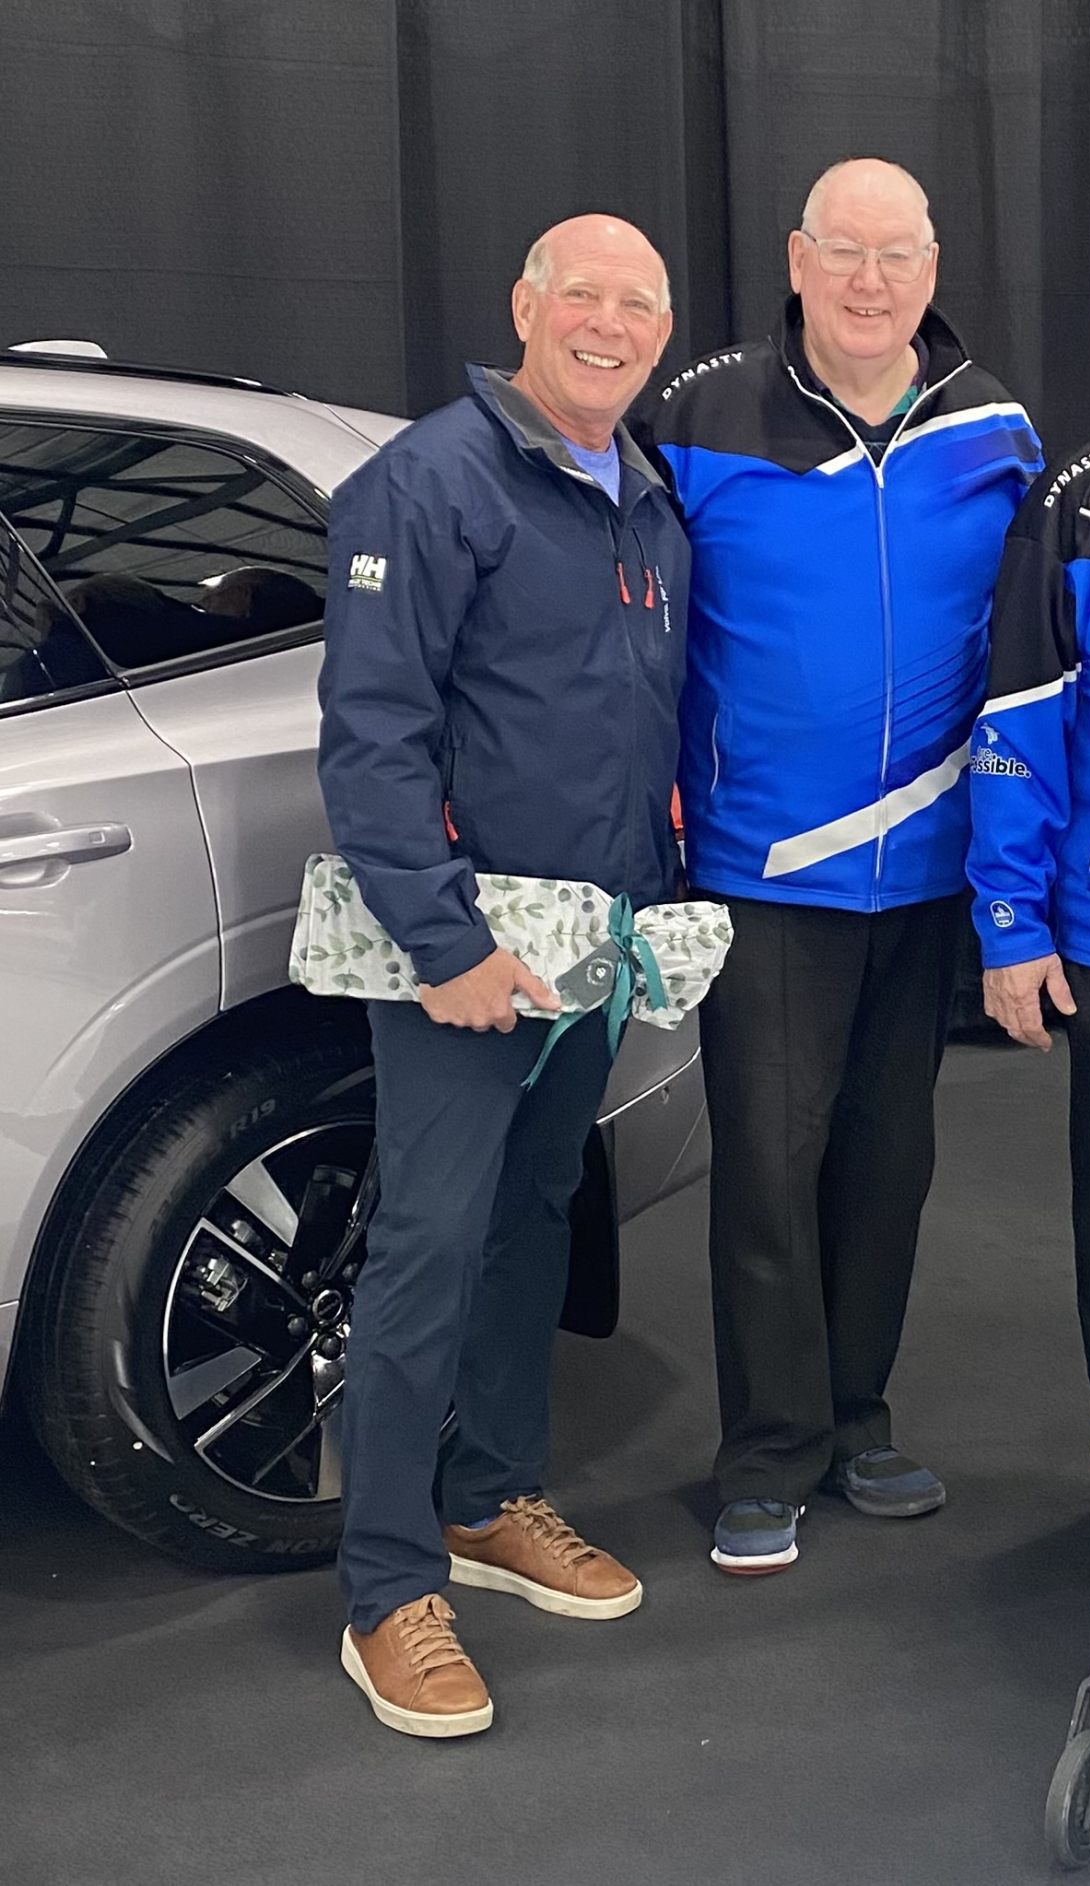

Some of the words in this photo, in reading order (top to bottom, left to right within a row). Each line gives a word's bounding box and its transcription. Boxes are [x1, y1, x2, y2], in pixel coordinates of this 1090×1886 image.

[661, 351, 743, 400] DYNASTY
[970, 754, 1032, 779] ssible.
[229, 1098, 276, 1139] R19
[169, 1493, 260, 1548] ZERO
